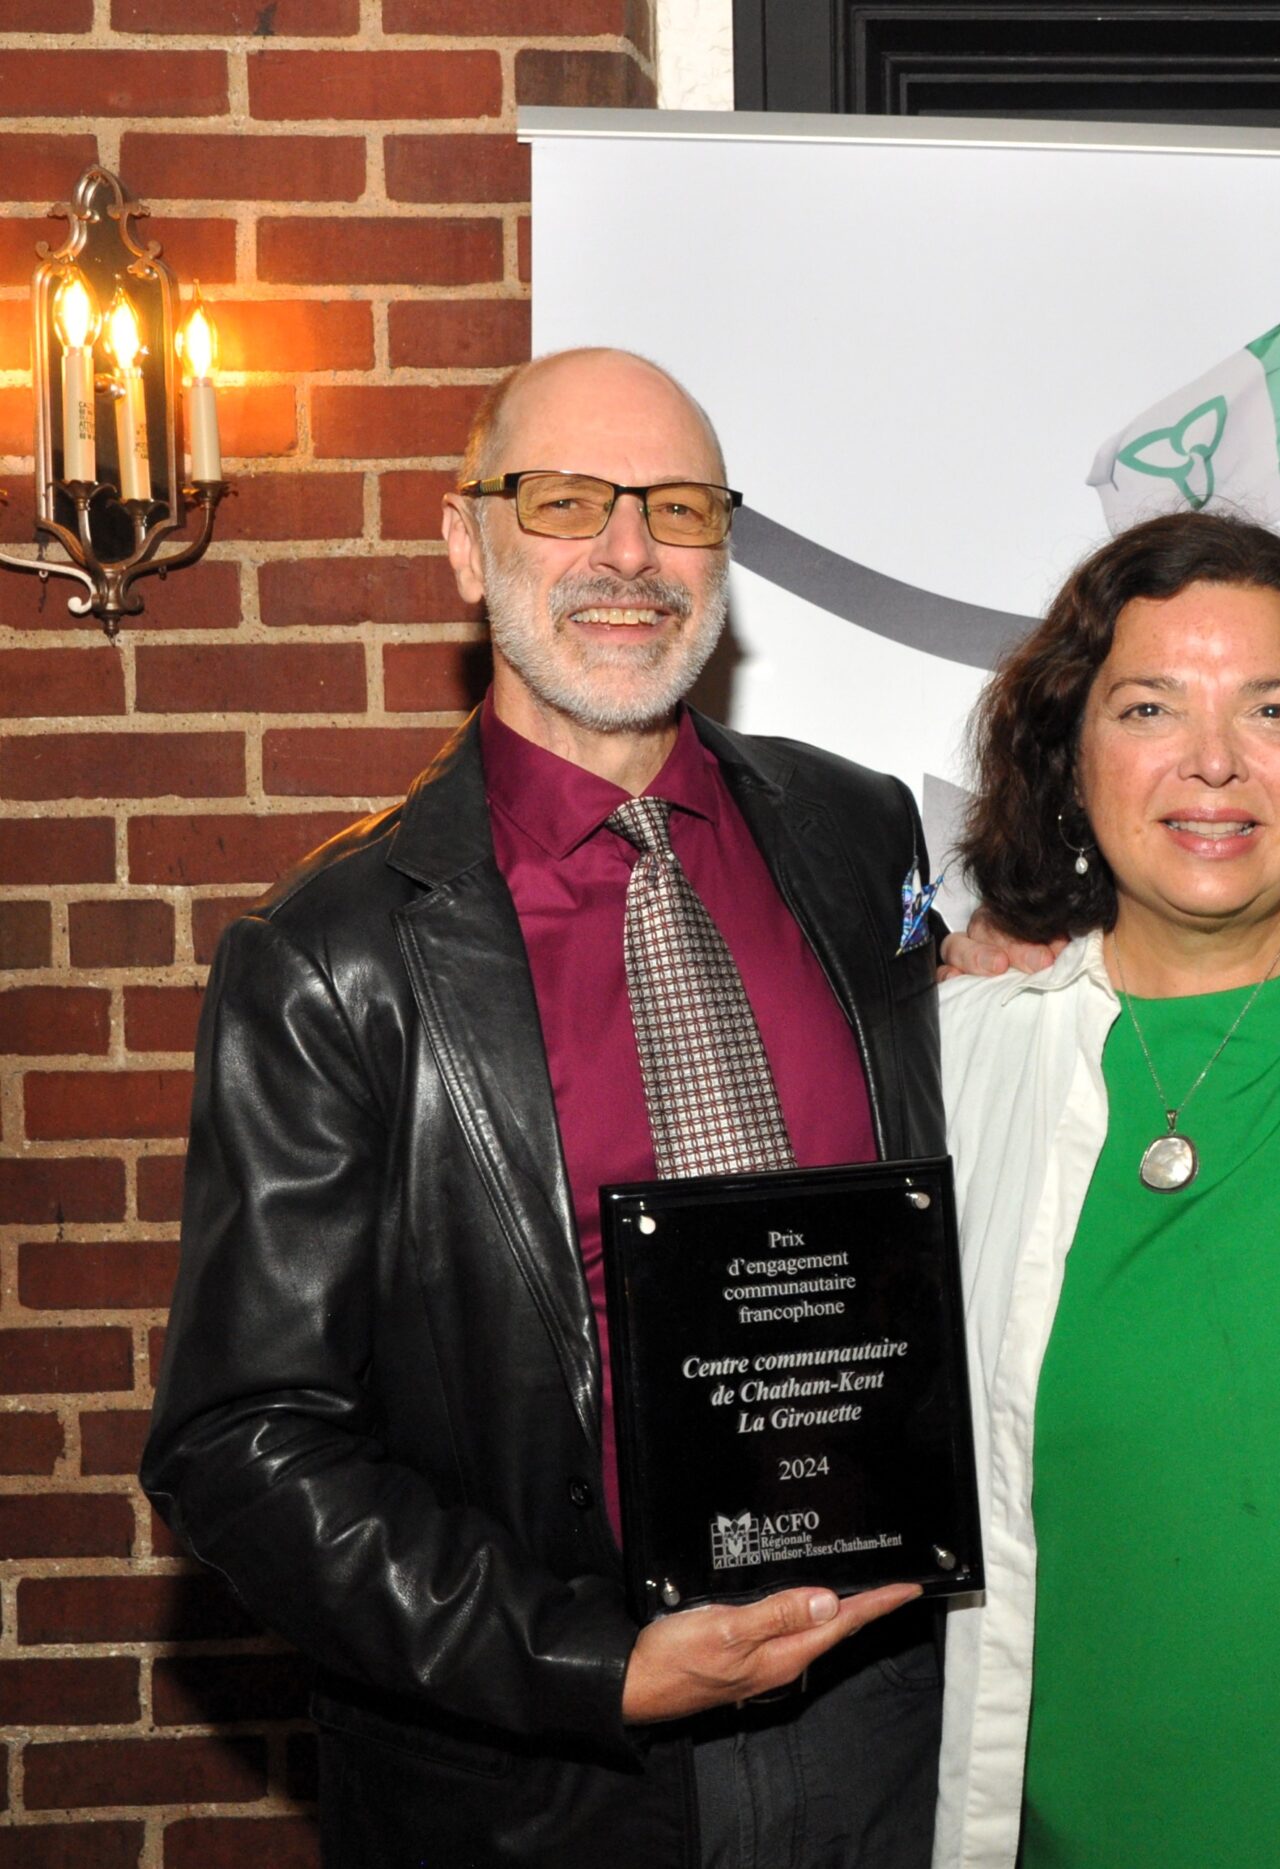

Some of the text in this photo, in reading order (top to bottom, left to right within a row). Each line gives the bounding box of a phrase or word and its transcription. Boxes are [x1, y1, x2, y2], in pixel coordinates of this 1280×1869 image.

[768, 1230, 804, 1249] Prix
[728, 1251, 849, 1277] d'engagement
[724, 1274, 856, 1300] communautaire
[739, 1301, 845, 1323] francophone
[683, 1338, 908, 1379] Centre communautaire
[711, 1371, 884, 1407] de Chatham-Kent
[738, 1404, 862, 1433] La Girouette
[779, 1456, 829, 1481] 2024
[761, 1511, 820, 1536] ACFO
[761, 1533, 812, 1549] Régionale
